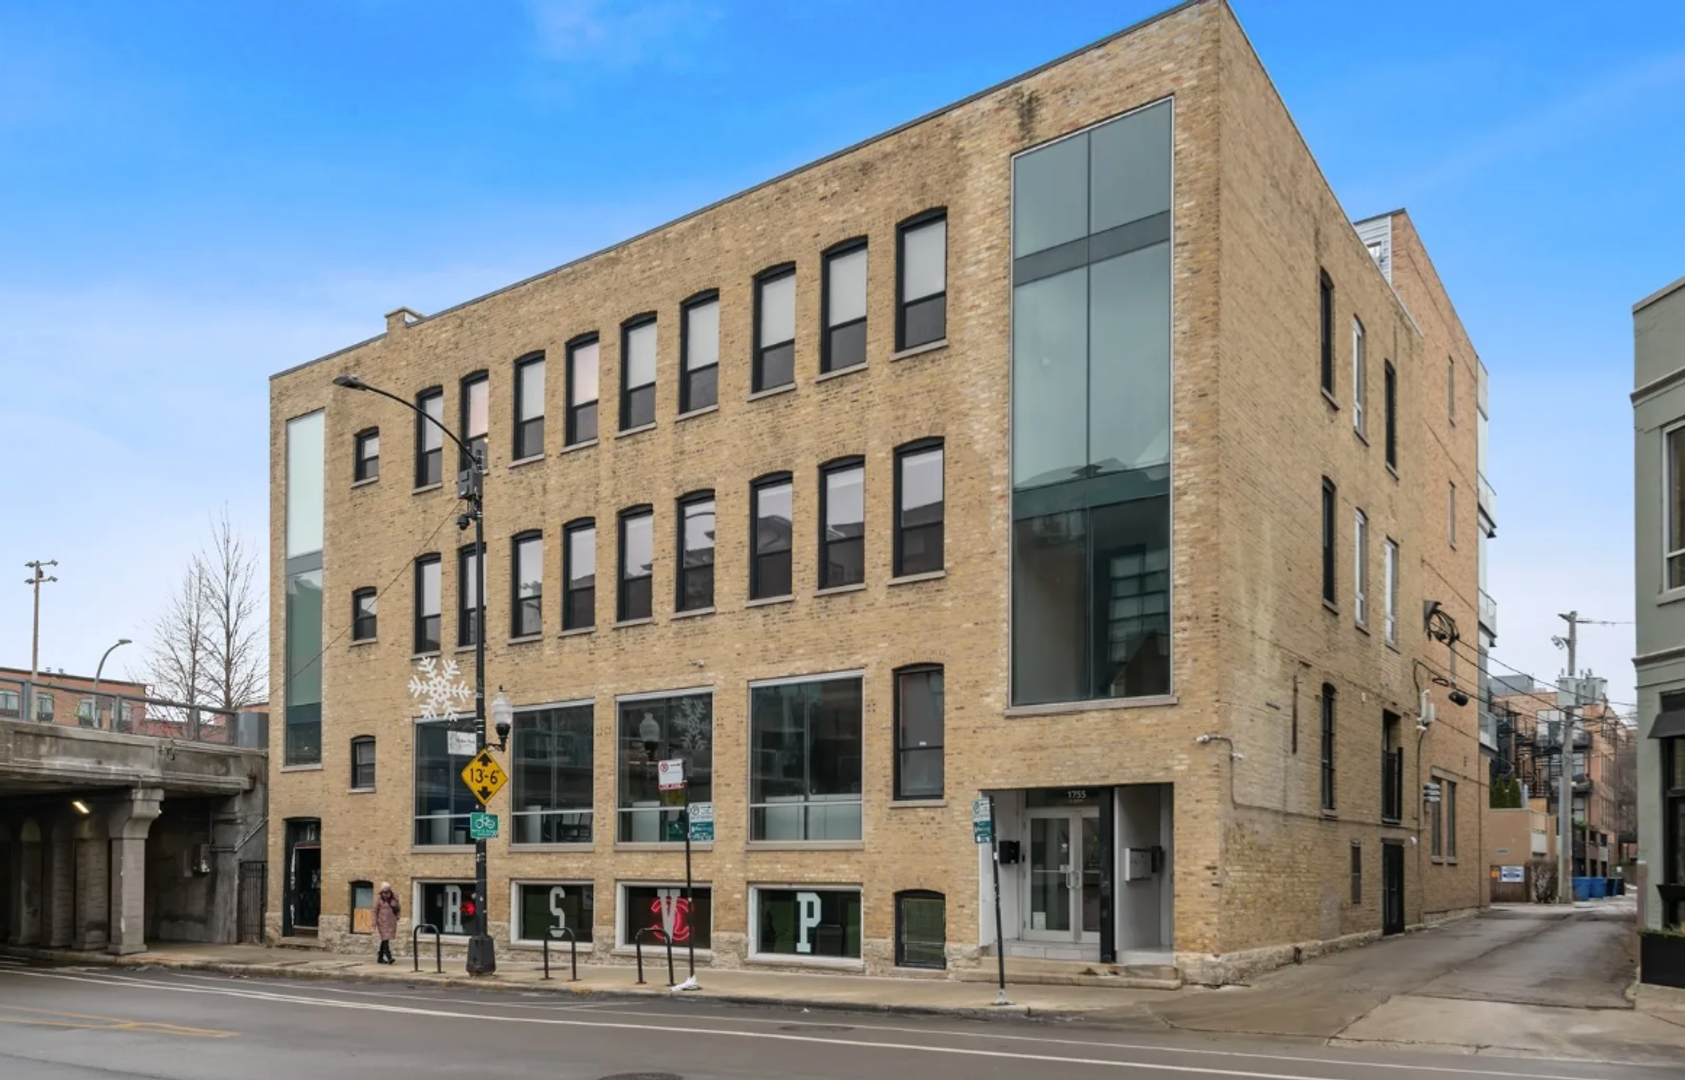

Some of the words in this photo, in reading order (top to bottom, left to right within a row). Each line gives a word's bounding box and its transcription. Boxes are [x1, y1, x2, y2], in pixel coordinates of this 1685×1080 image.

[1067, 790, 1087, 799] 1755
[549, 886, 566, 938] S
[656, 888, 682, 944] V
[796, 892, 822, 953] P
